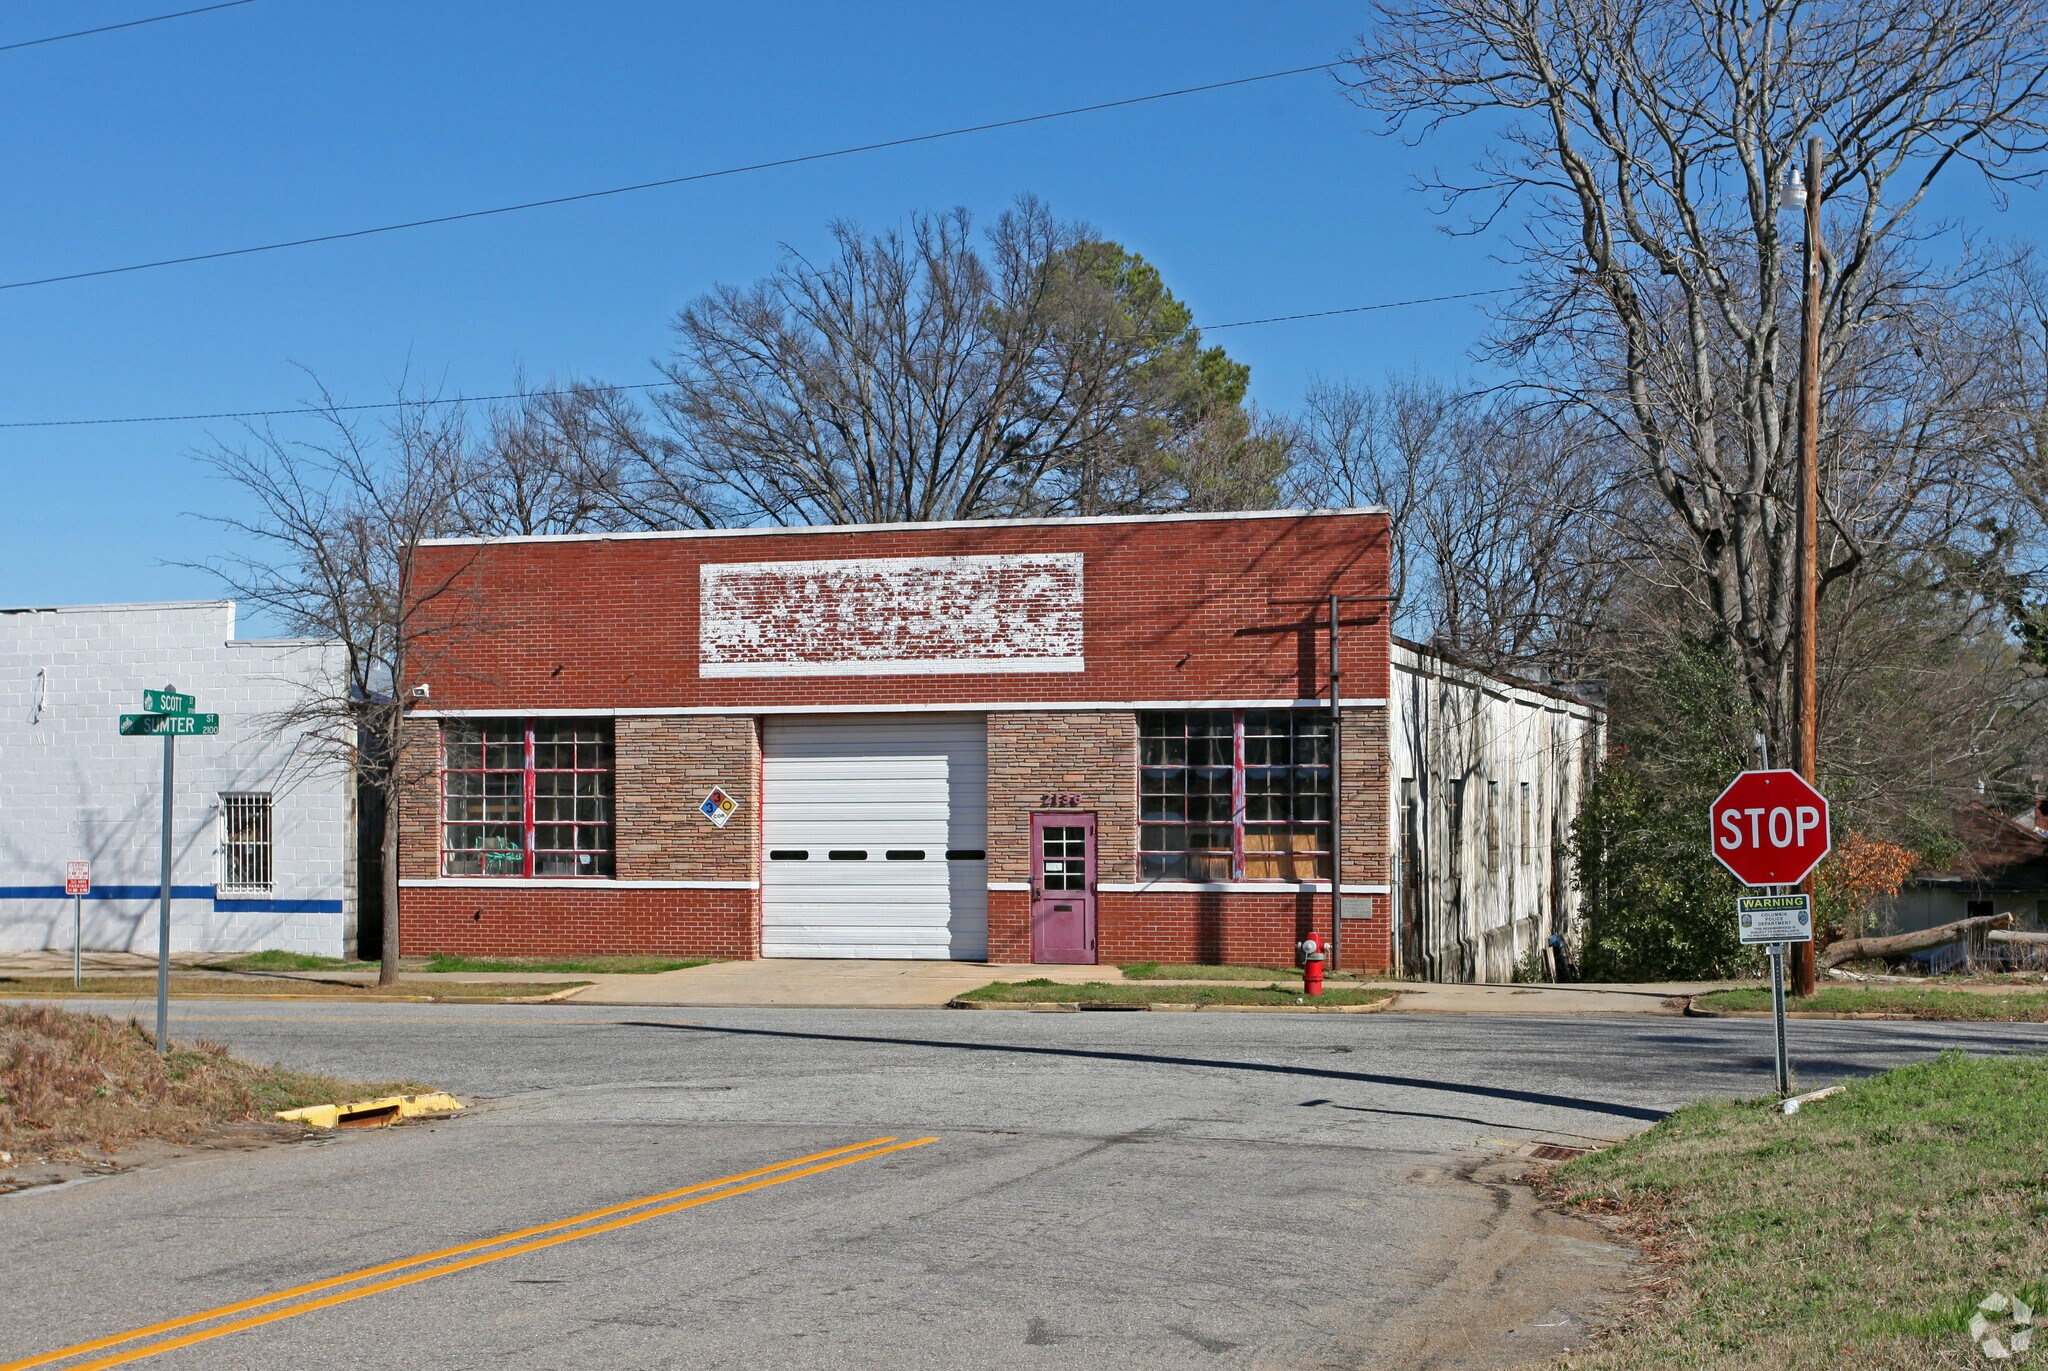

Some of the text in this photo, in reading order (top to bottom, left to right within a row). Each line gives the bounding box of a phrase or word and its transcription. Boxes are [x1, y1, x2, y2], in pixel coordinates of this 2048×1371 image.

[160, 694, 182, 712] SCOTT
[143, 714, 215, 733] SUMTER ST
[202, 726, 218, 735] 2100
[713, 792, 721, 803] 3
[705, 802, 714, 813] 3
[1720, 806, 1820, 850] STOP
[1743, 897, 1803, 908] WARNING
